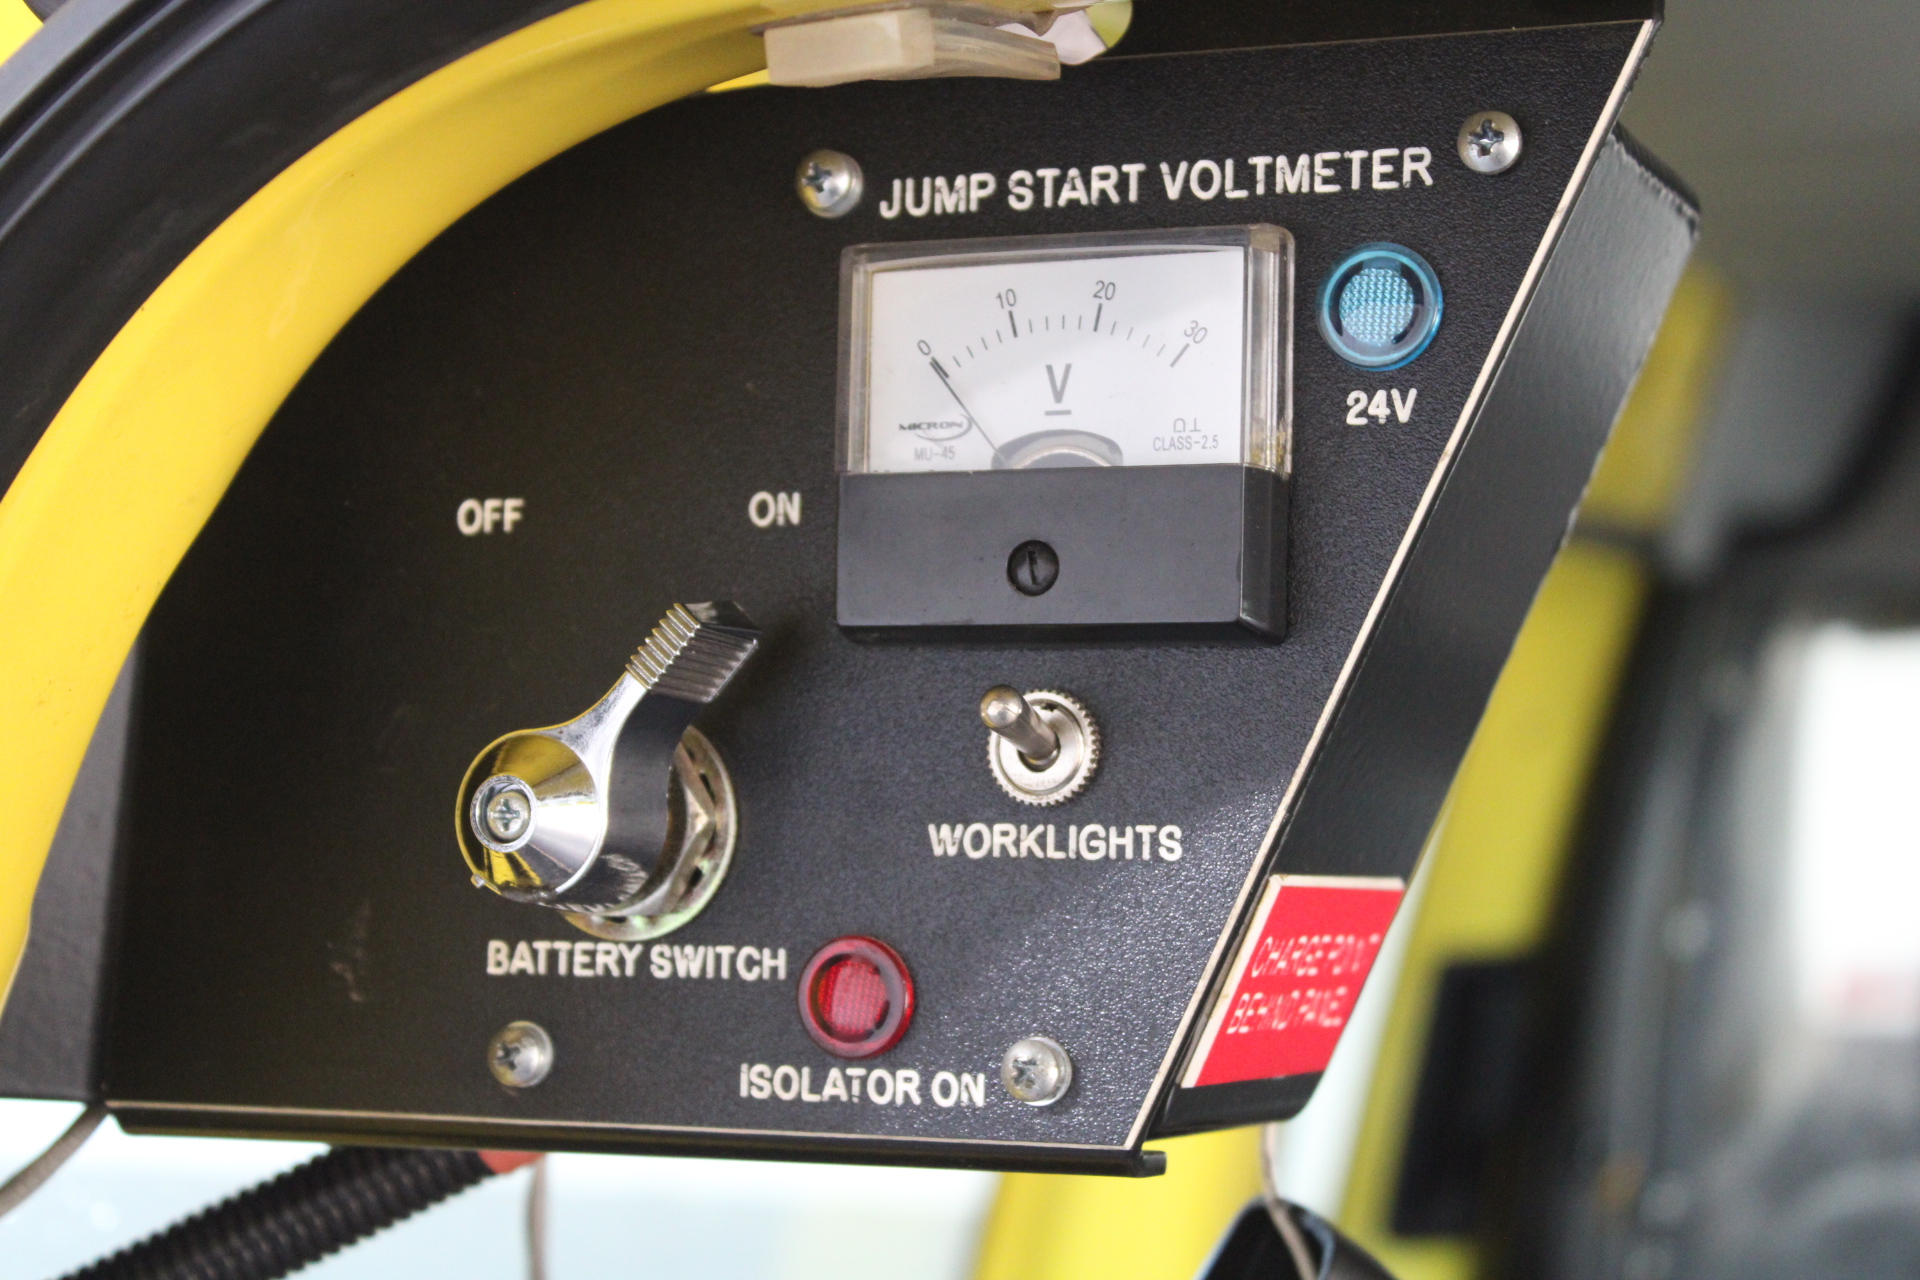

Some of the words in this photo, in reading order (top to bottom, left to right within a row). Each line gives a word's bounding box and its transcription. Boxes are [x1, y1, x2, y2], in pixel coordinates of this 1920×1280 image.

[879, 171, 998, 220] JUMP
[1006, 161, 1146, 212] START
[1159, 145, 1435, 200] VOLTMETER
[994, 287, 1018, 310] 10
[1091, 279, 1118, 302] 20
[916, 338, 936, 360] 0
[1182, 319, 1209, 346] 30
[1045, 363, 1073, 405] V
[1345, 386, 1419, 427] 24V
[898, 420, 964, 432] MICRON
[1151, 433, 1220, 452] CLASS-2.5
[913, 444, 957, 462] MU-45
[455, 497, 524, 536] OFF
[747, 490, 802, 528] ON
[927, 822, 1184, 863] WORKLIGHTS
[486, 939, 641, 979] BATTERY
[649, 943, 788, 983] SWITCH
[739, 1062, 922, 1108] ISOLATOR
[929, 1069, 988, 1109] ON
